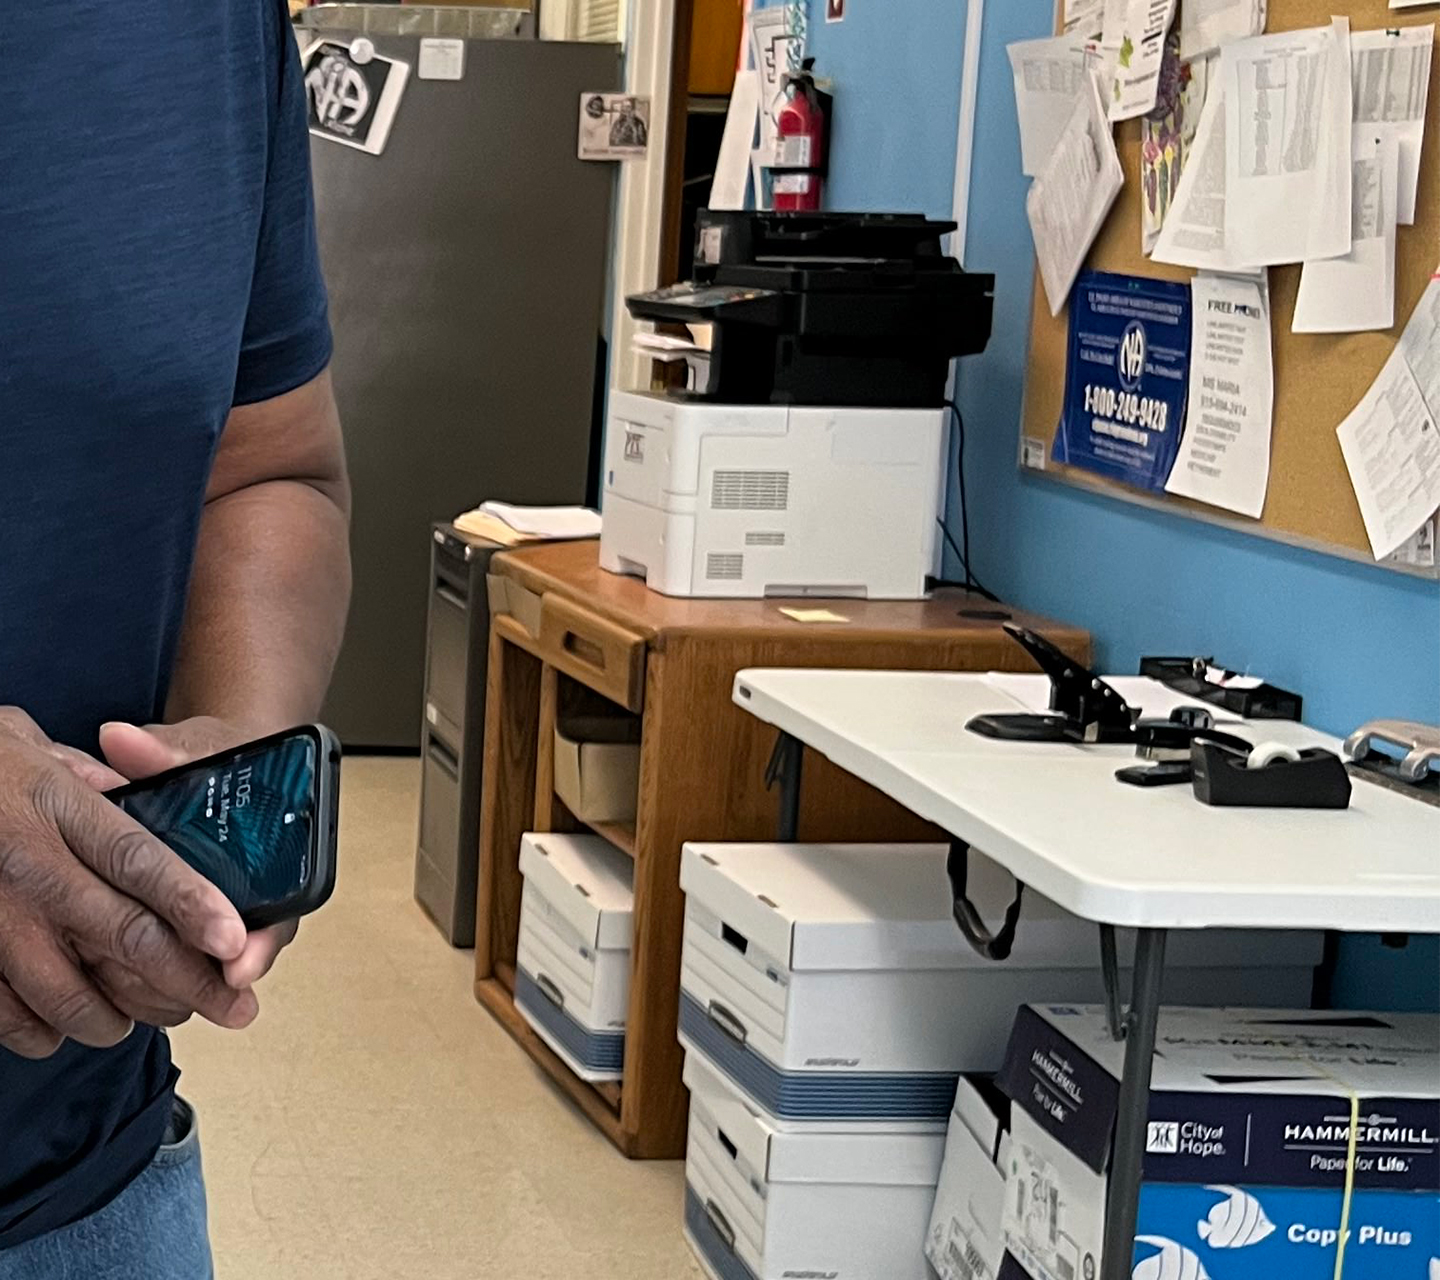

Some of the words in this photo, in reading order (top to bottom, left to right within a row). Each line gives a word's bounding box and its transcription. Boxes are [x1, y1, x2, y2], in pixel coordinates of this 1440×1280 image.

[1181, 1122, 1213, 1140] City
[1287, 1223, 1351, 1247] Copy
[1359, 1225, 1413, 1246] Plus
